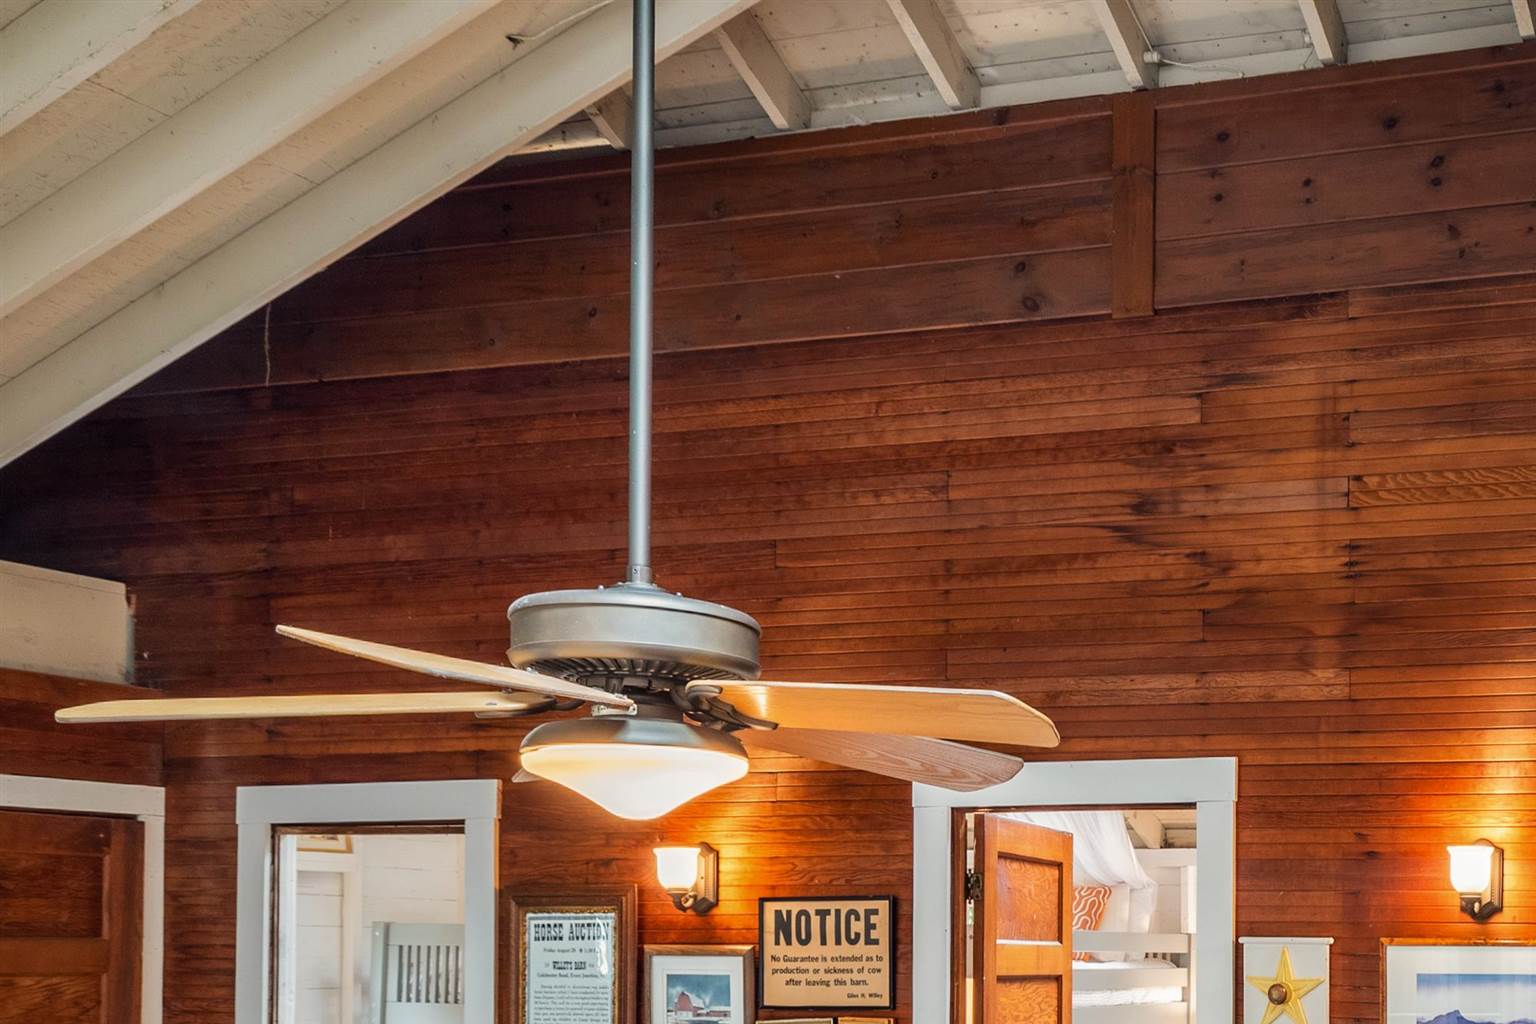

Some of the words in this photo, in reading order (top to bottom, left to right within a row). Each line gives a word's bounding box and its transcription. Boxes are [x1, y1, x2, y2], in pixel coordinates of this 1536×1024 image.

[534, 923, 564, 942] HORSE
[568, 922, 610, 941] AUCTION
[774, 908, 880, 946] NOTICE
[770, 955, 780, 963] No
[782, 954, 819, 963] Guarantee
[821, 955, 828, 963] is
[830, 954, 864, 963] extended
[771, 966, 809, 976] production
[824, 966, 854, 974] sickness
[857, 966, 865, 974] of
[785, 978, 802, 986] after
[805, 978, 831, 987] leaving
[834, 978, 847, 986] this
[850, 978, 869, 986] barn.
